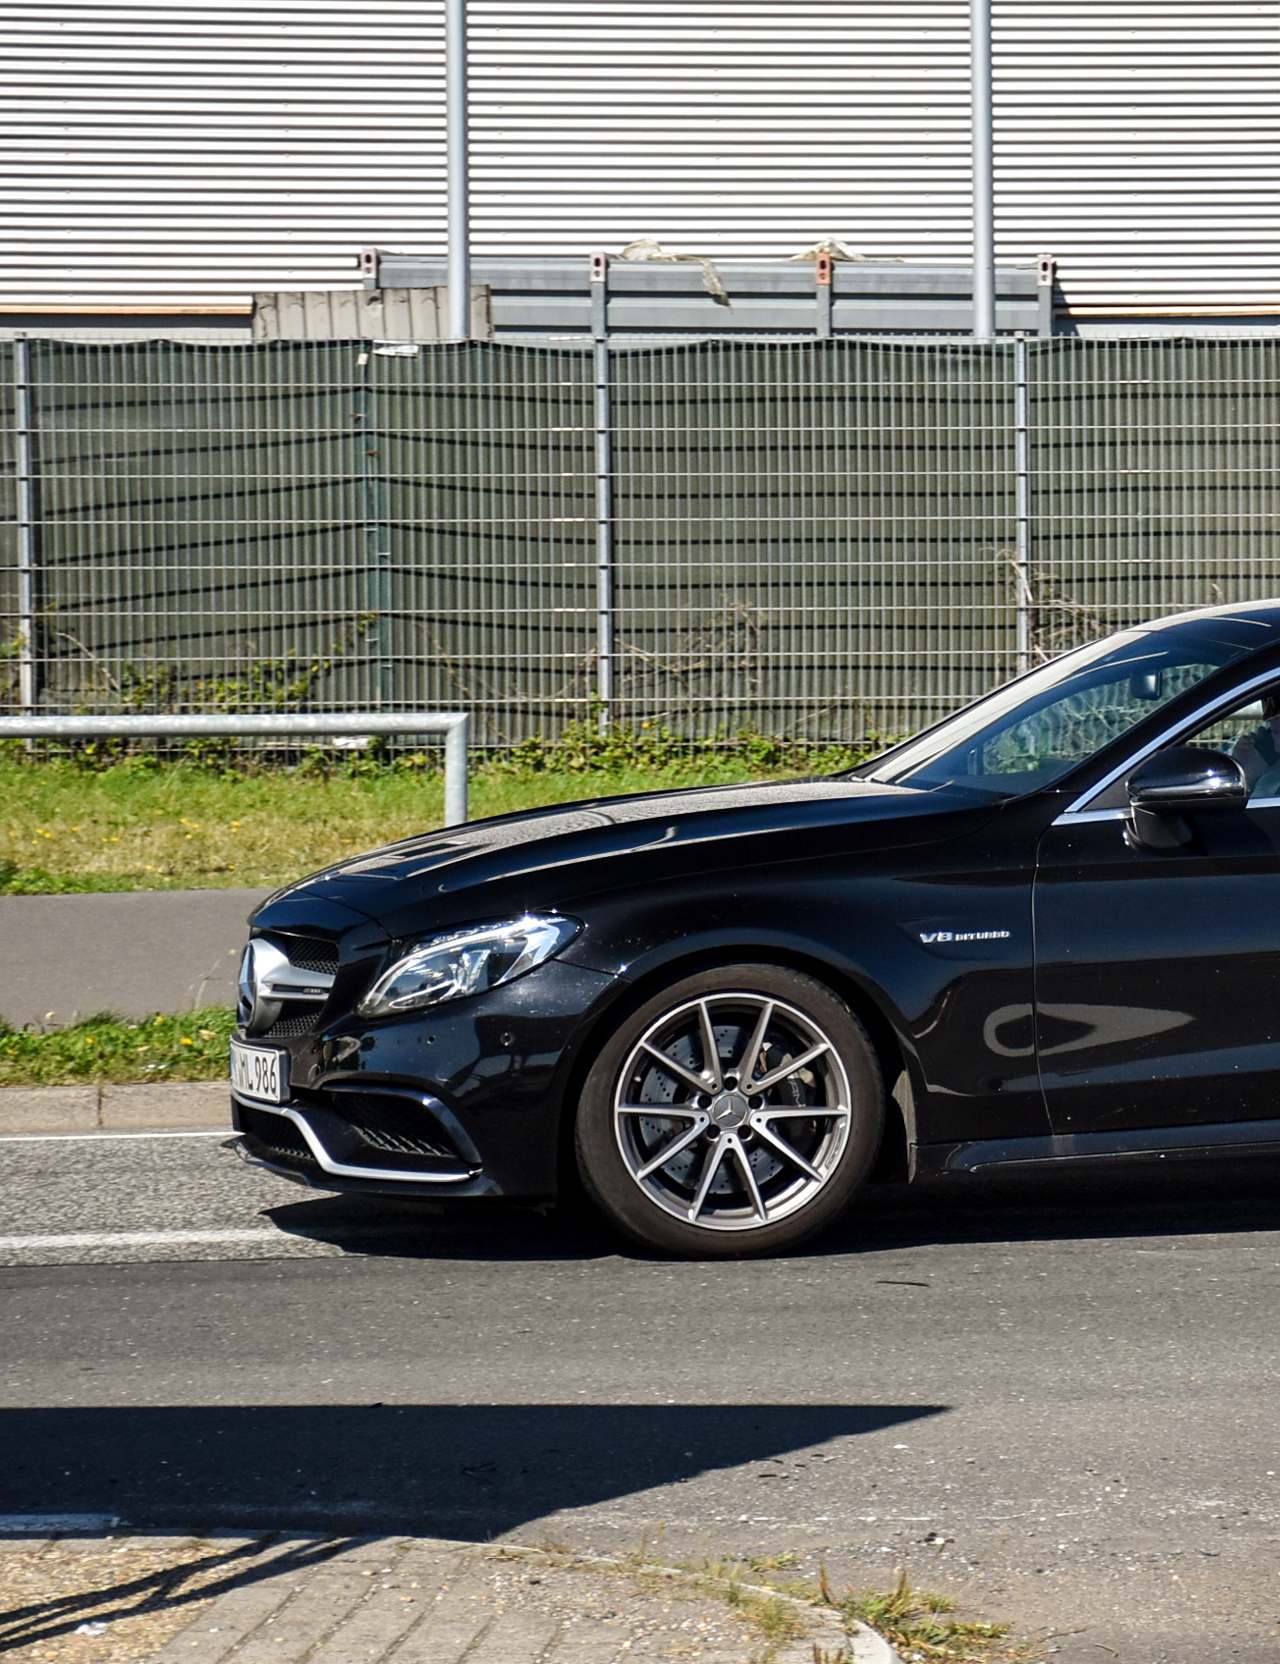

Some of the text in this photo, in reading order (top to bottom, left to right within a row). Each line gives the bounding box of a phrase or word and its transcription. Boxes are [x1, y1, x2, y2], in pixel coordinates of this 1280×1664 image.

[919, 930, 1011, 943] V8 BITURBO
[254, 1055, 277, 1094] 986
